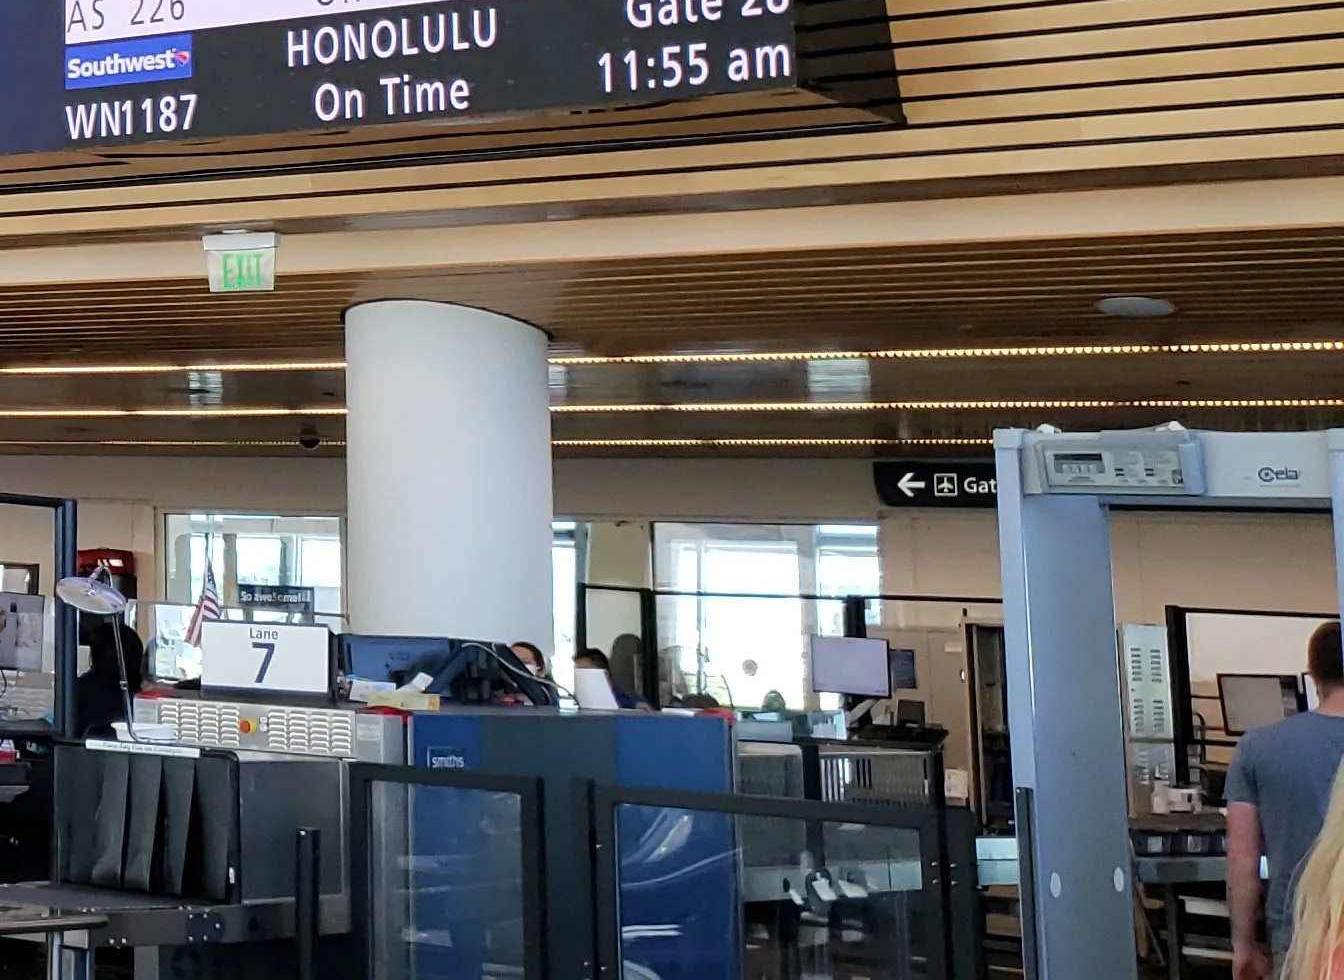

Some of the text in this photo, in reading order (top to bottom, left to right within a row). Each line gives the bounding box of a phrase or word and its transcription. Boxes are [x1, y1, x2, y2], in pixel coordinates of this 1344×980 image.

[68, 0, 105, 34] AS
[287, 8, 498, 68] HONOLULU
[68, 45, 174, 79] Southwest
[597, 40, 790, 93] 11:55 am
[66, 94, 198, 140] WN1187
[314, 74, 470, 121] On Time
[223, 252, 263, 288] EXIT
[250, 627, 279, 640] Lane
[251, 641, 275, 684] 7
